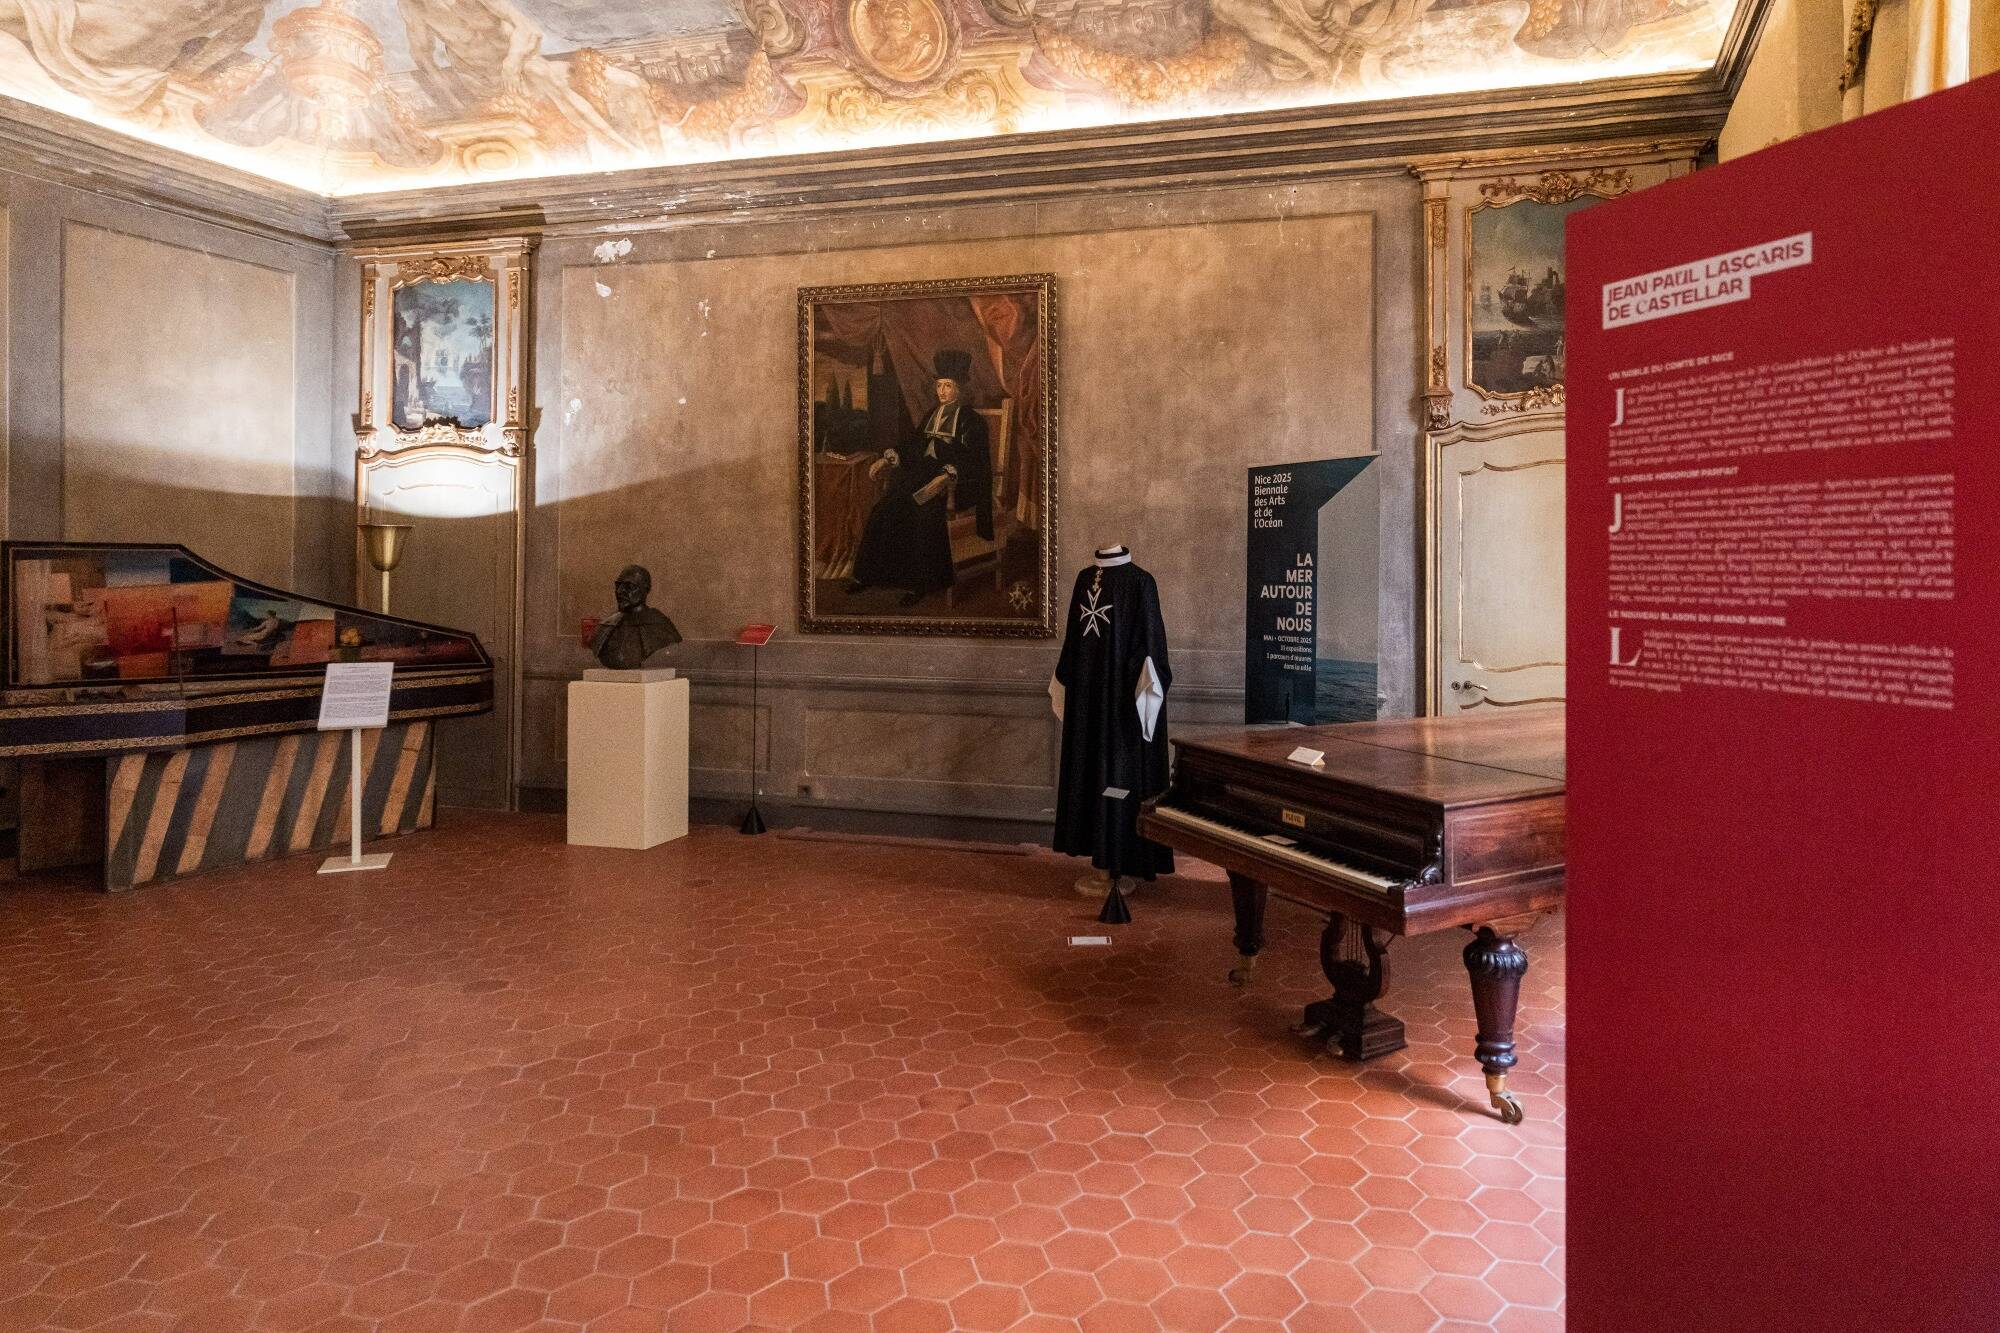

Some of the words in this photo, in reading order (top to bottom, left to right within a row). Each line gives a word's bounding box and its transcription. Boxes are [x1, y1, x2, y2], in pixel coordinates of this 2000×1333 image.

[1608, 280, 1647, 306] JEAN
[1653, 268, 1699, 292] PAUL
[1706, 241, 1804, 278] LASCARIS
[1609, 302, 1631, 321] DE
[1636, 278, 1743, 315] CASTELLAR
[1711, 351, 1734, 362] NICE
[1255, 475, 1271, 484] Nice
[1273, 473, 1292, 484] 2025
[1255, 484, 1288, 495] Biennale
[1255, 497, 1268, 506] des
[1269, 496, 1285, 506] Arts
[1254, 508, 1261, 517] et
[1264, 507, 1272, 517] de
[1296, 553, 1313, 567] LA
[1286, 569, 1313, 582] MER
[1260, 585, 1312, 599] AUTOUR
[1296, 602, 1312, 616] DE
[1609, 610, 1619, 619] LE
[1698, 613, 1711, 622] DU
[1277, 617, 1312, 632] NOUS
